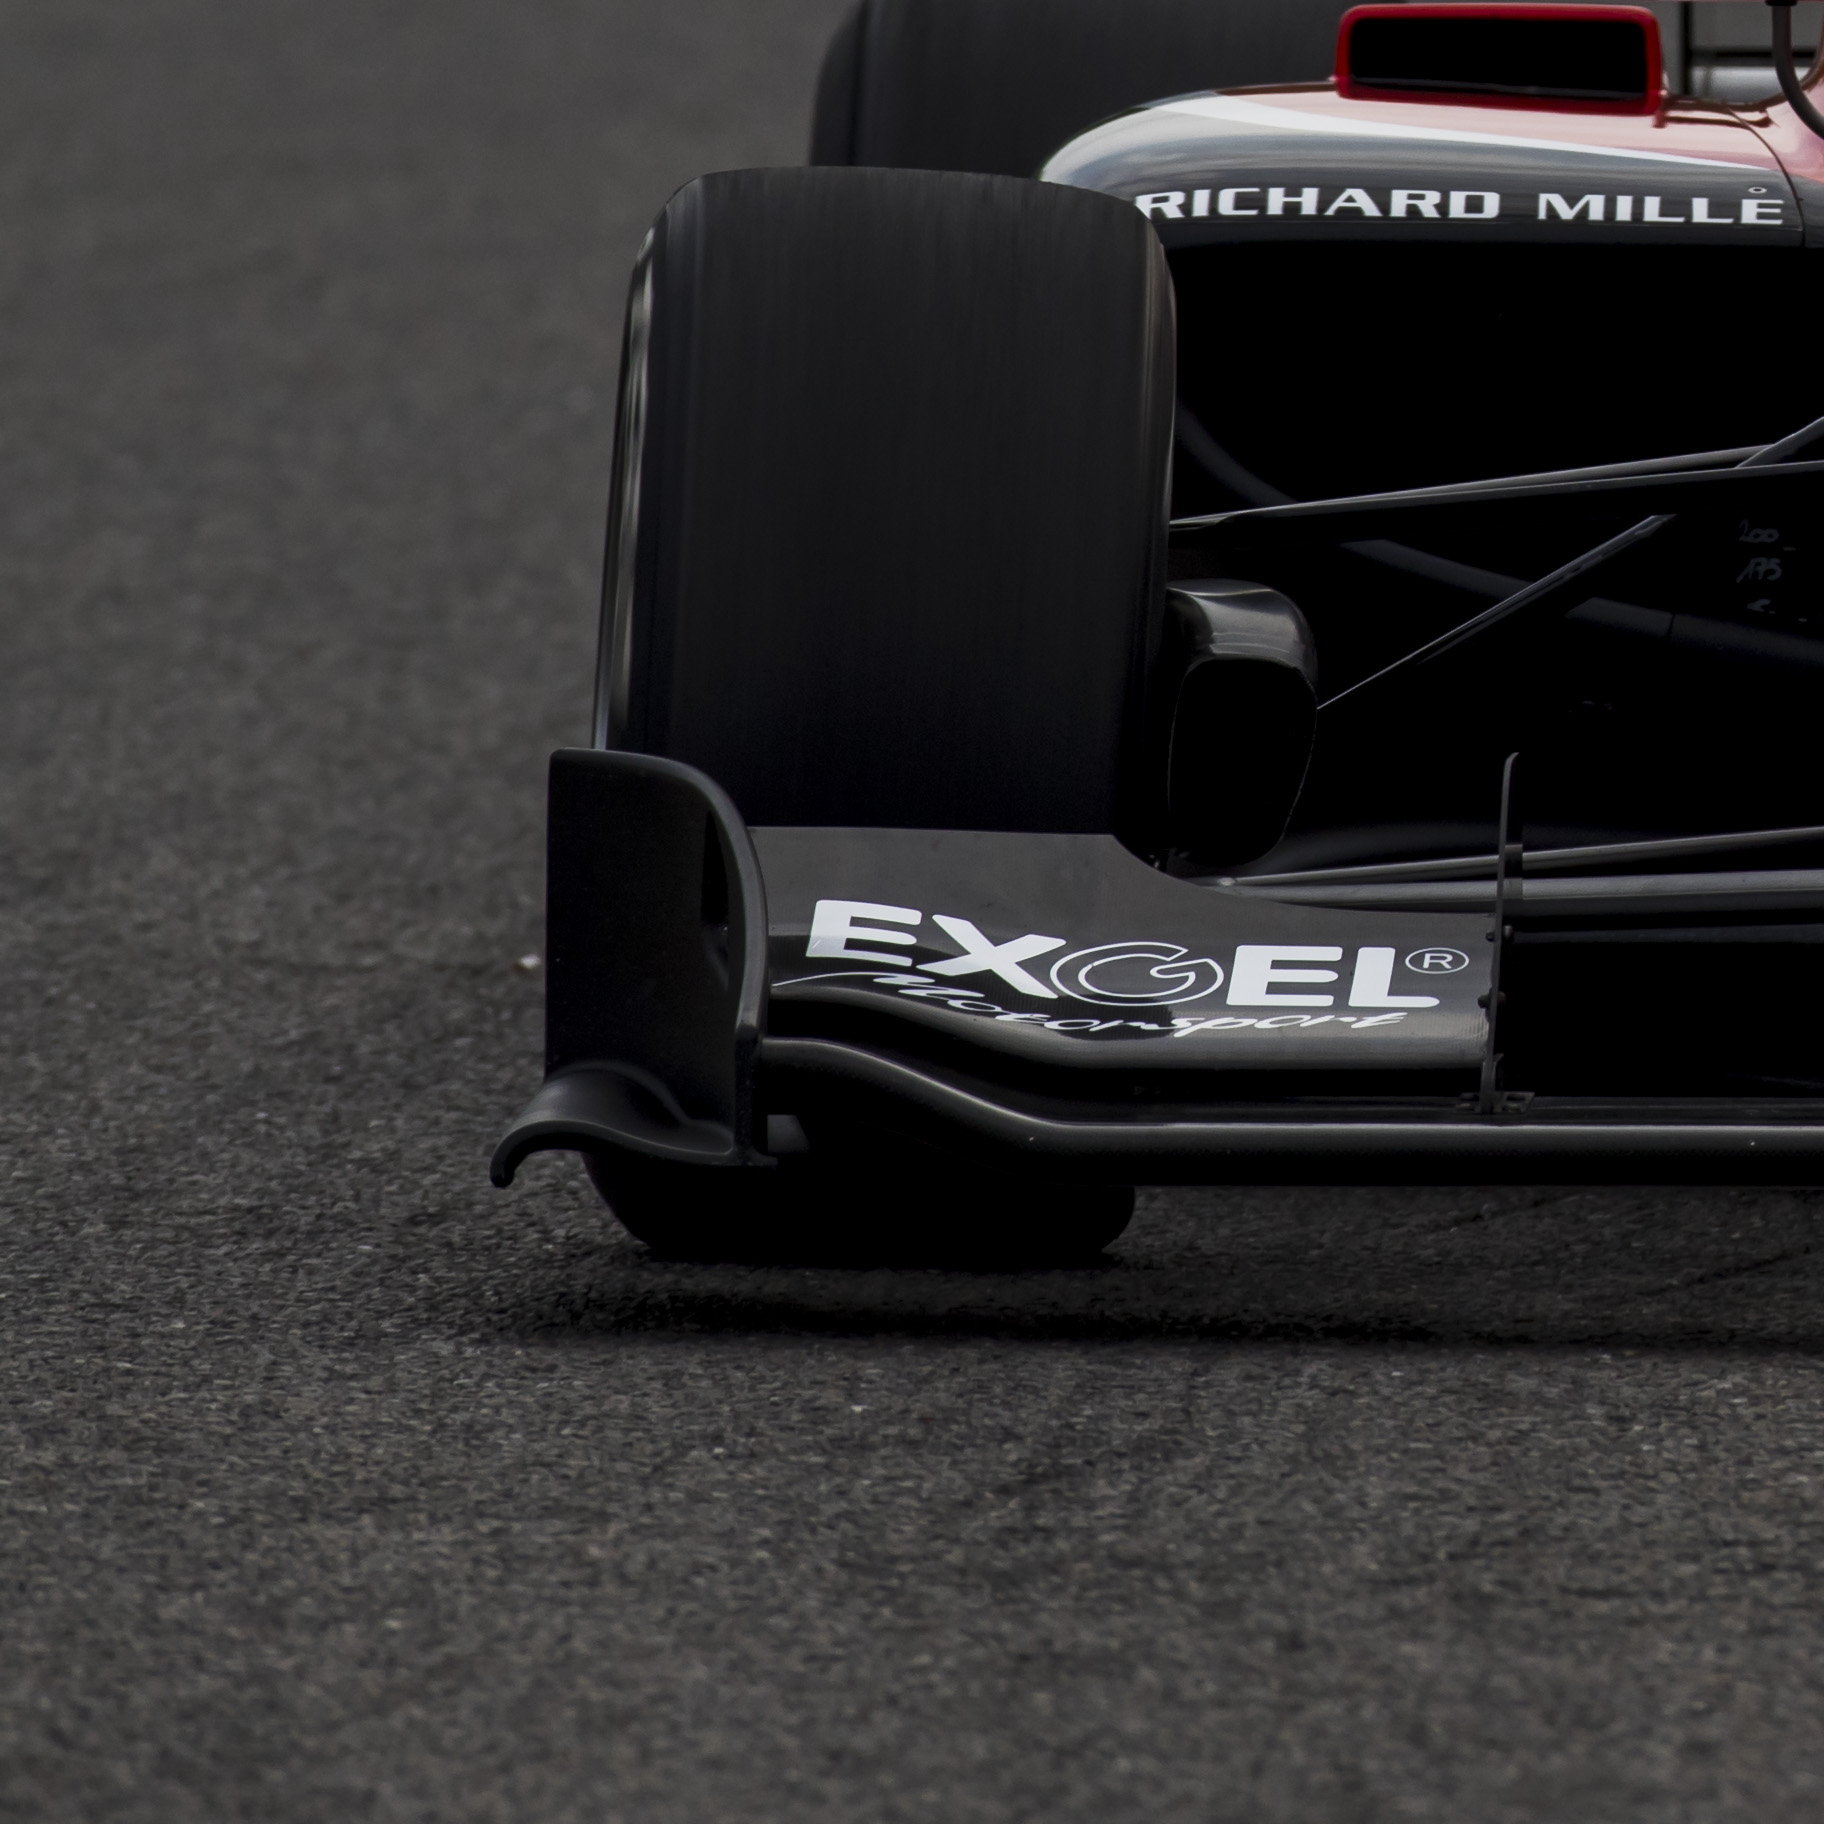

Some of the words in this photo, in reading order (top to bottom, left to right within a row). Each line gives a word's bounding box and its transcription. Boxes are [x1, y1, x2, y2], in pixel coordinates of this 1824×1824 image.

[1134, 186, 1502, 222] RICHARD
[1536, 192, 1784, 227] MILLE
[772, 971, 1410, 1038] Motorsport
